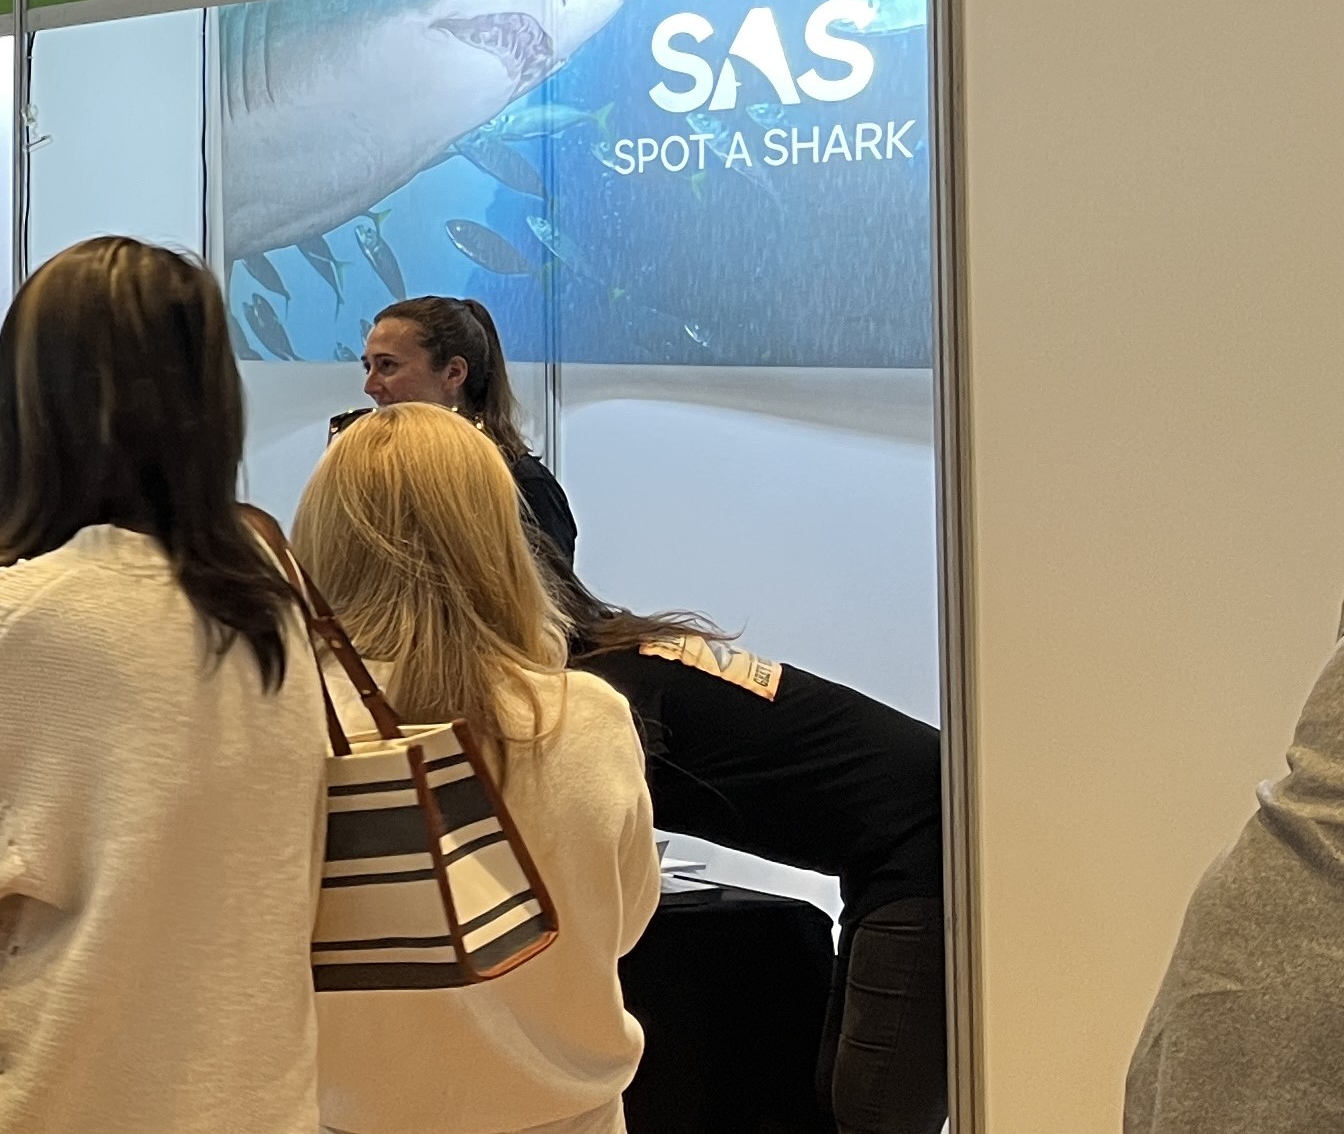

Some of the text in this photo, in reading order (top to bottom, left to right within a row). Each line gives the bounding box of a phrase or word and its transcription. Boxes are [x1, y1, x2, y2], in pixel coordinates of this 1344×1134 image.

[614, 119, 916, 175] SPOT A SHARK
